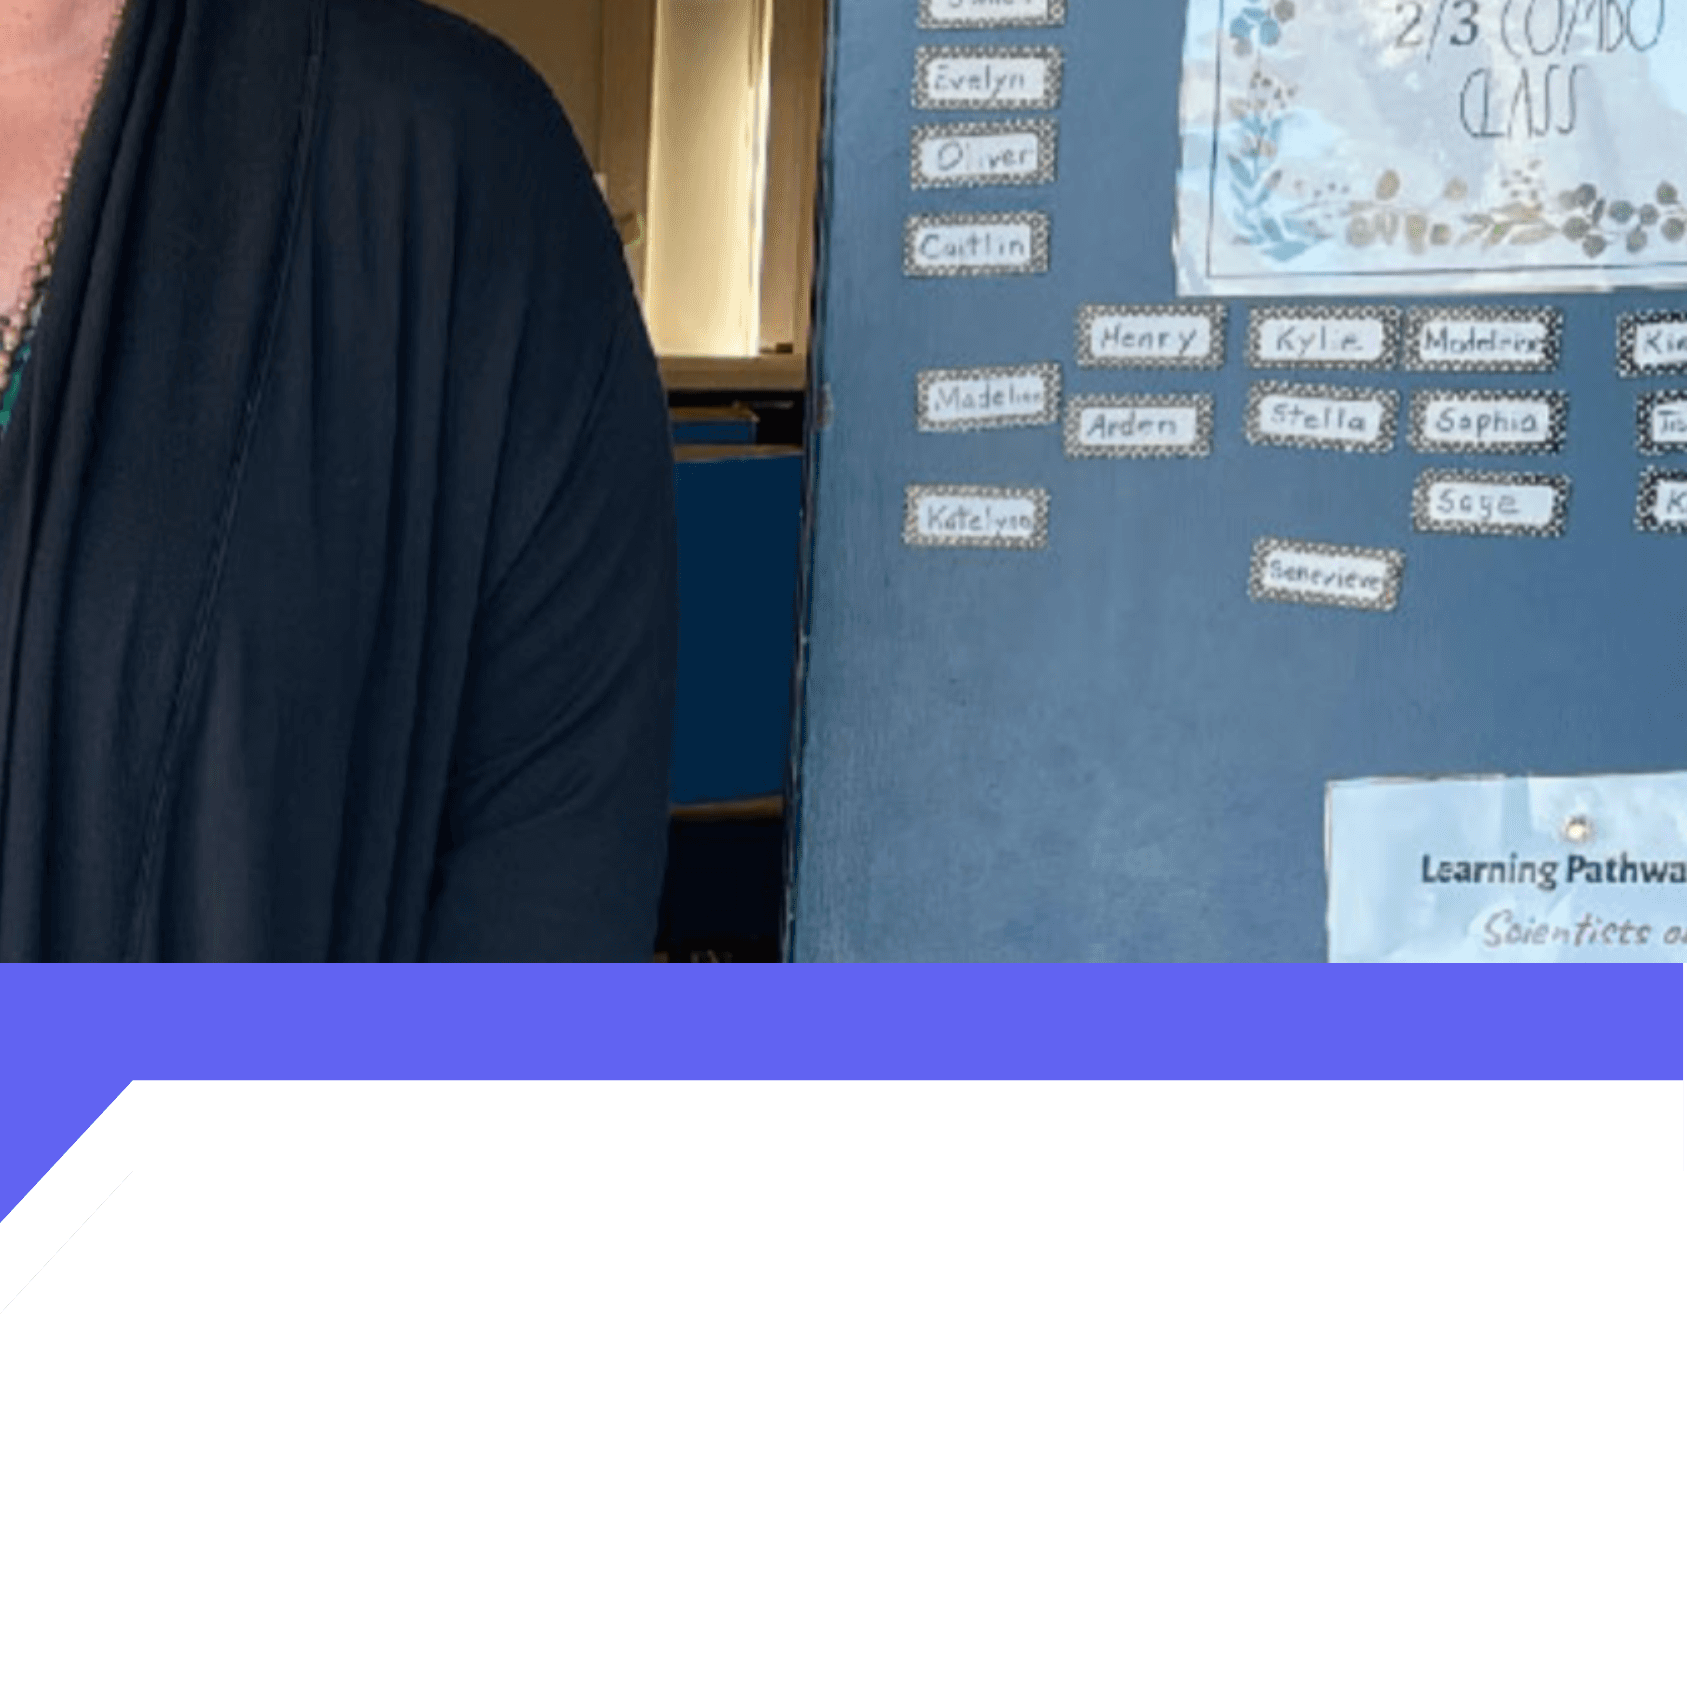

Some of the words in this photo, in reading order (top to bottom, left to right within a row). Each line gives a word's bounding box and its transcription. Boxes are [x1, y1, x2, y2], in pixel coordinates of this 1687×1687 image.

[933, 64, 1025, 99] Evelyn
[1459, 64, 1588, 139] CLASS
[937, 141, 1034, 171] Oliver
[1100, 321, 1198, 355] Henry
[1271, 403, 1367, 433] Stella
[1435, 406, 1539, 438] Sophia
[1421, 853, 1557, 891] Learning
[1482, 908, 1653, 948] Scientists
